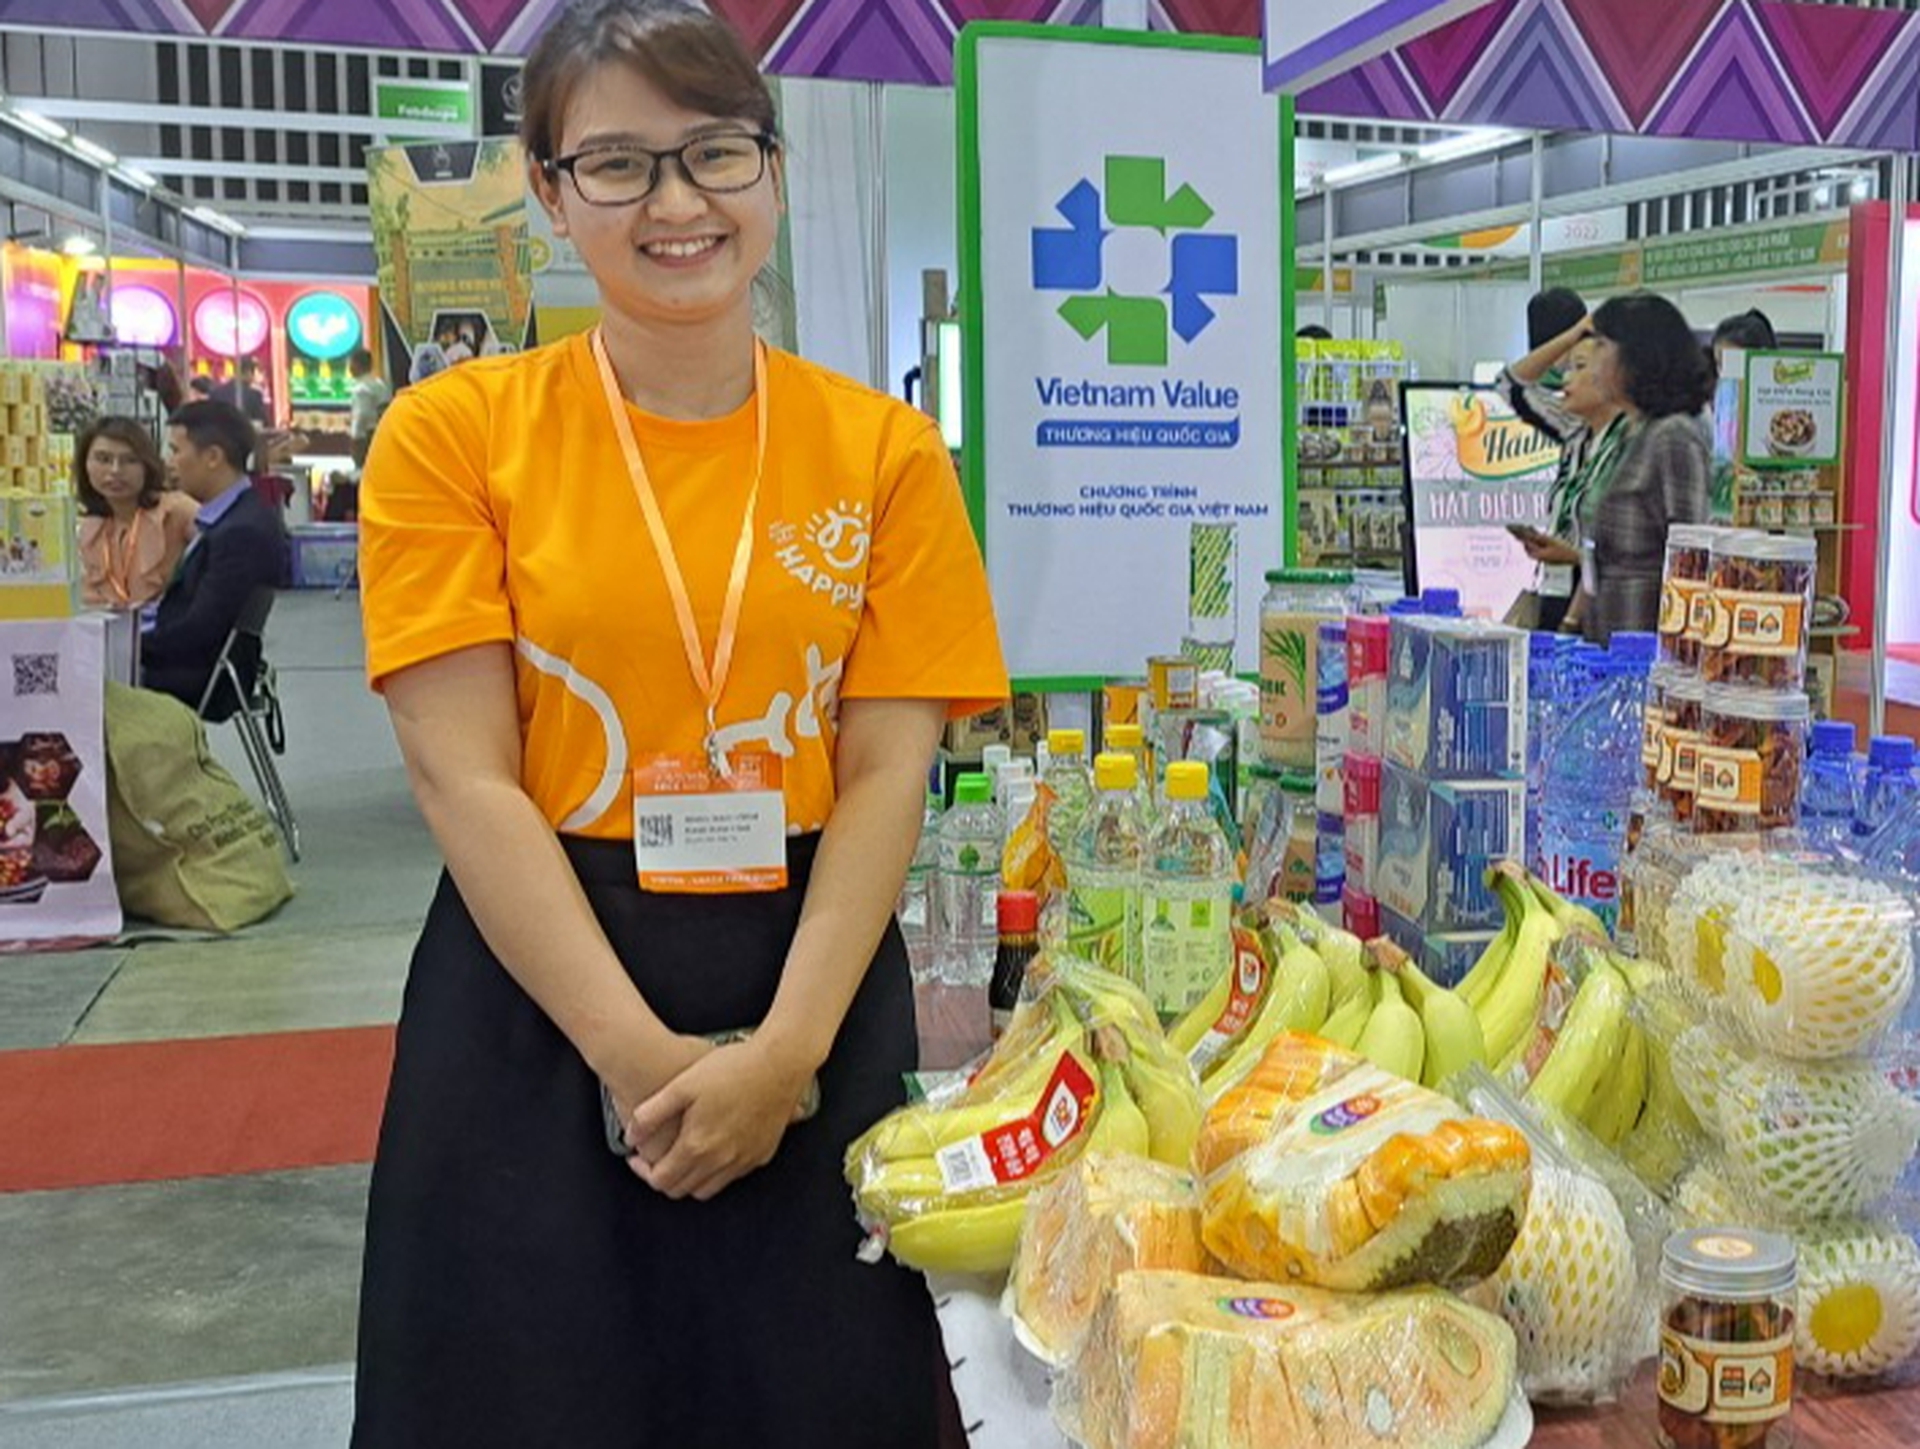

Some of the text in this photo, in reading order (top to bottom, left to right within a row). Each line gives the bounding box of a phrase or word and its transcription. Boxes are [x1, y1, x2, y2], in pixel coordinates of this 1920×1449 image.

[1036, 377, 1240, 409] Vietnam Value
[1045, 425, 1232, 447] THƯƠNG HIỆU QUỐC GIA
[1080, 484, 1198, 499] CHƯƠNG TRÌNH
[1008, 502, 1269, 519] THƯƠNG HIỆU QUỐC GIA VIỆT NAM
[1553, 853, 1617, 899] Life
